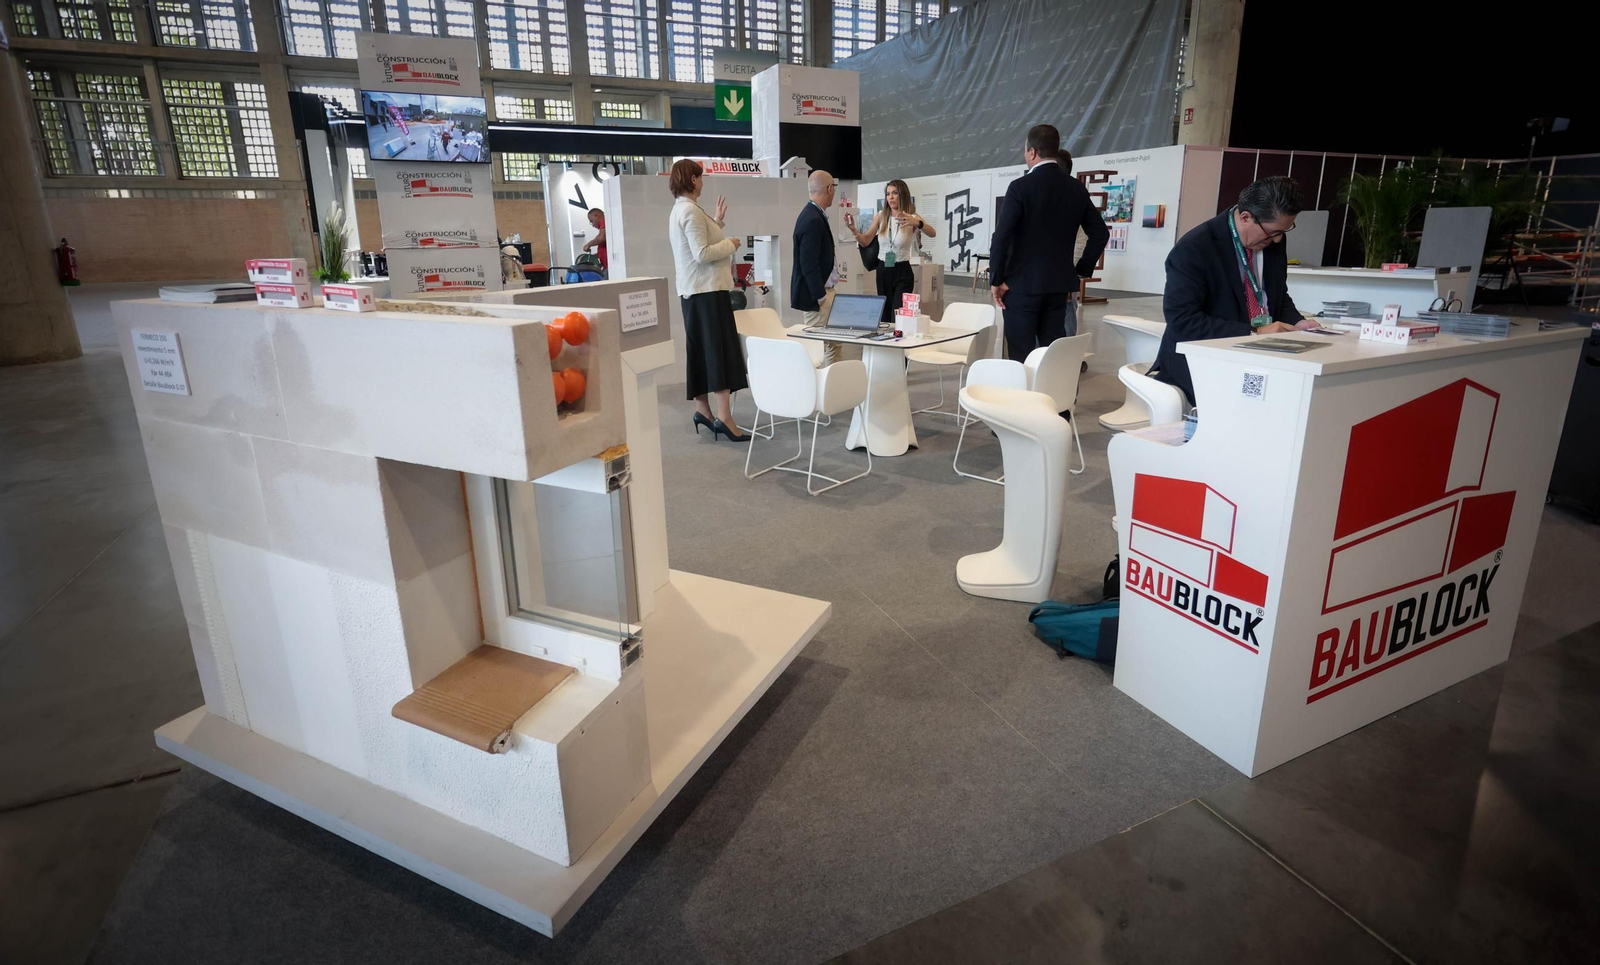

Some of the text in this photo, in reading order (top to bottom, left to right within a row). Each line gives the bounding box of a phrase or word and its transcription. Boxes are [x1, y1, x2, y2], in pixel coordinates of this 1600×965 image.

[376, 56, 446, 65] CONSTRUCCIÓN
[723, 63, 757, 75] PUERTA
[422, 71, 460, 81] BAUBLOCK
[791, 94, 840, 102] CONSTRUCCIÓN
[712, 161, 761, 173] BAUBLOCK
[396, 171, 462, 180] CONSTRUCCIÓN
[405, 230, 468, 238] CONSTRUCCIÓN
[410, 266, 475, 275] CONSTRUCCIÓN
[140, 333, 159, 342] TERMECO
[143, 380, 157, 388] Detalle
[157, 381, 176, 390] Baublock
